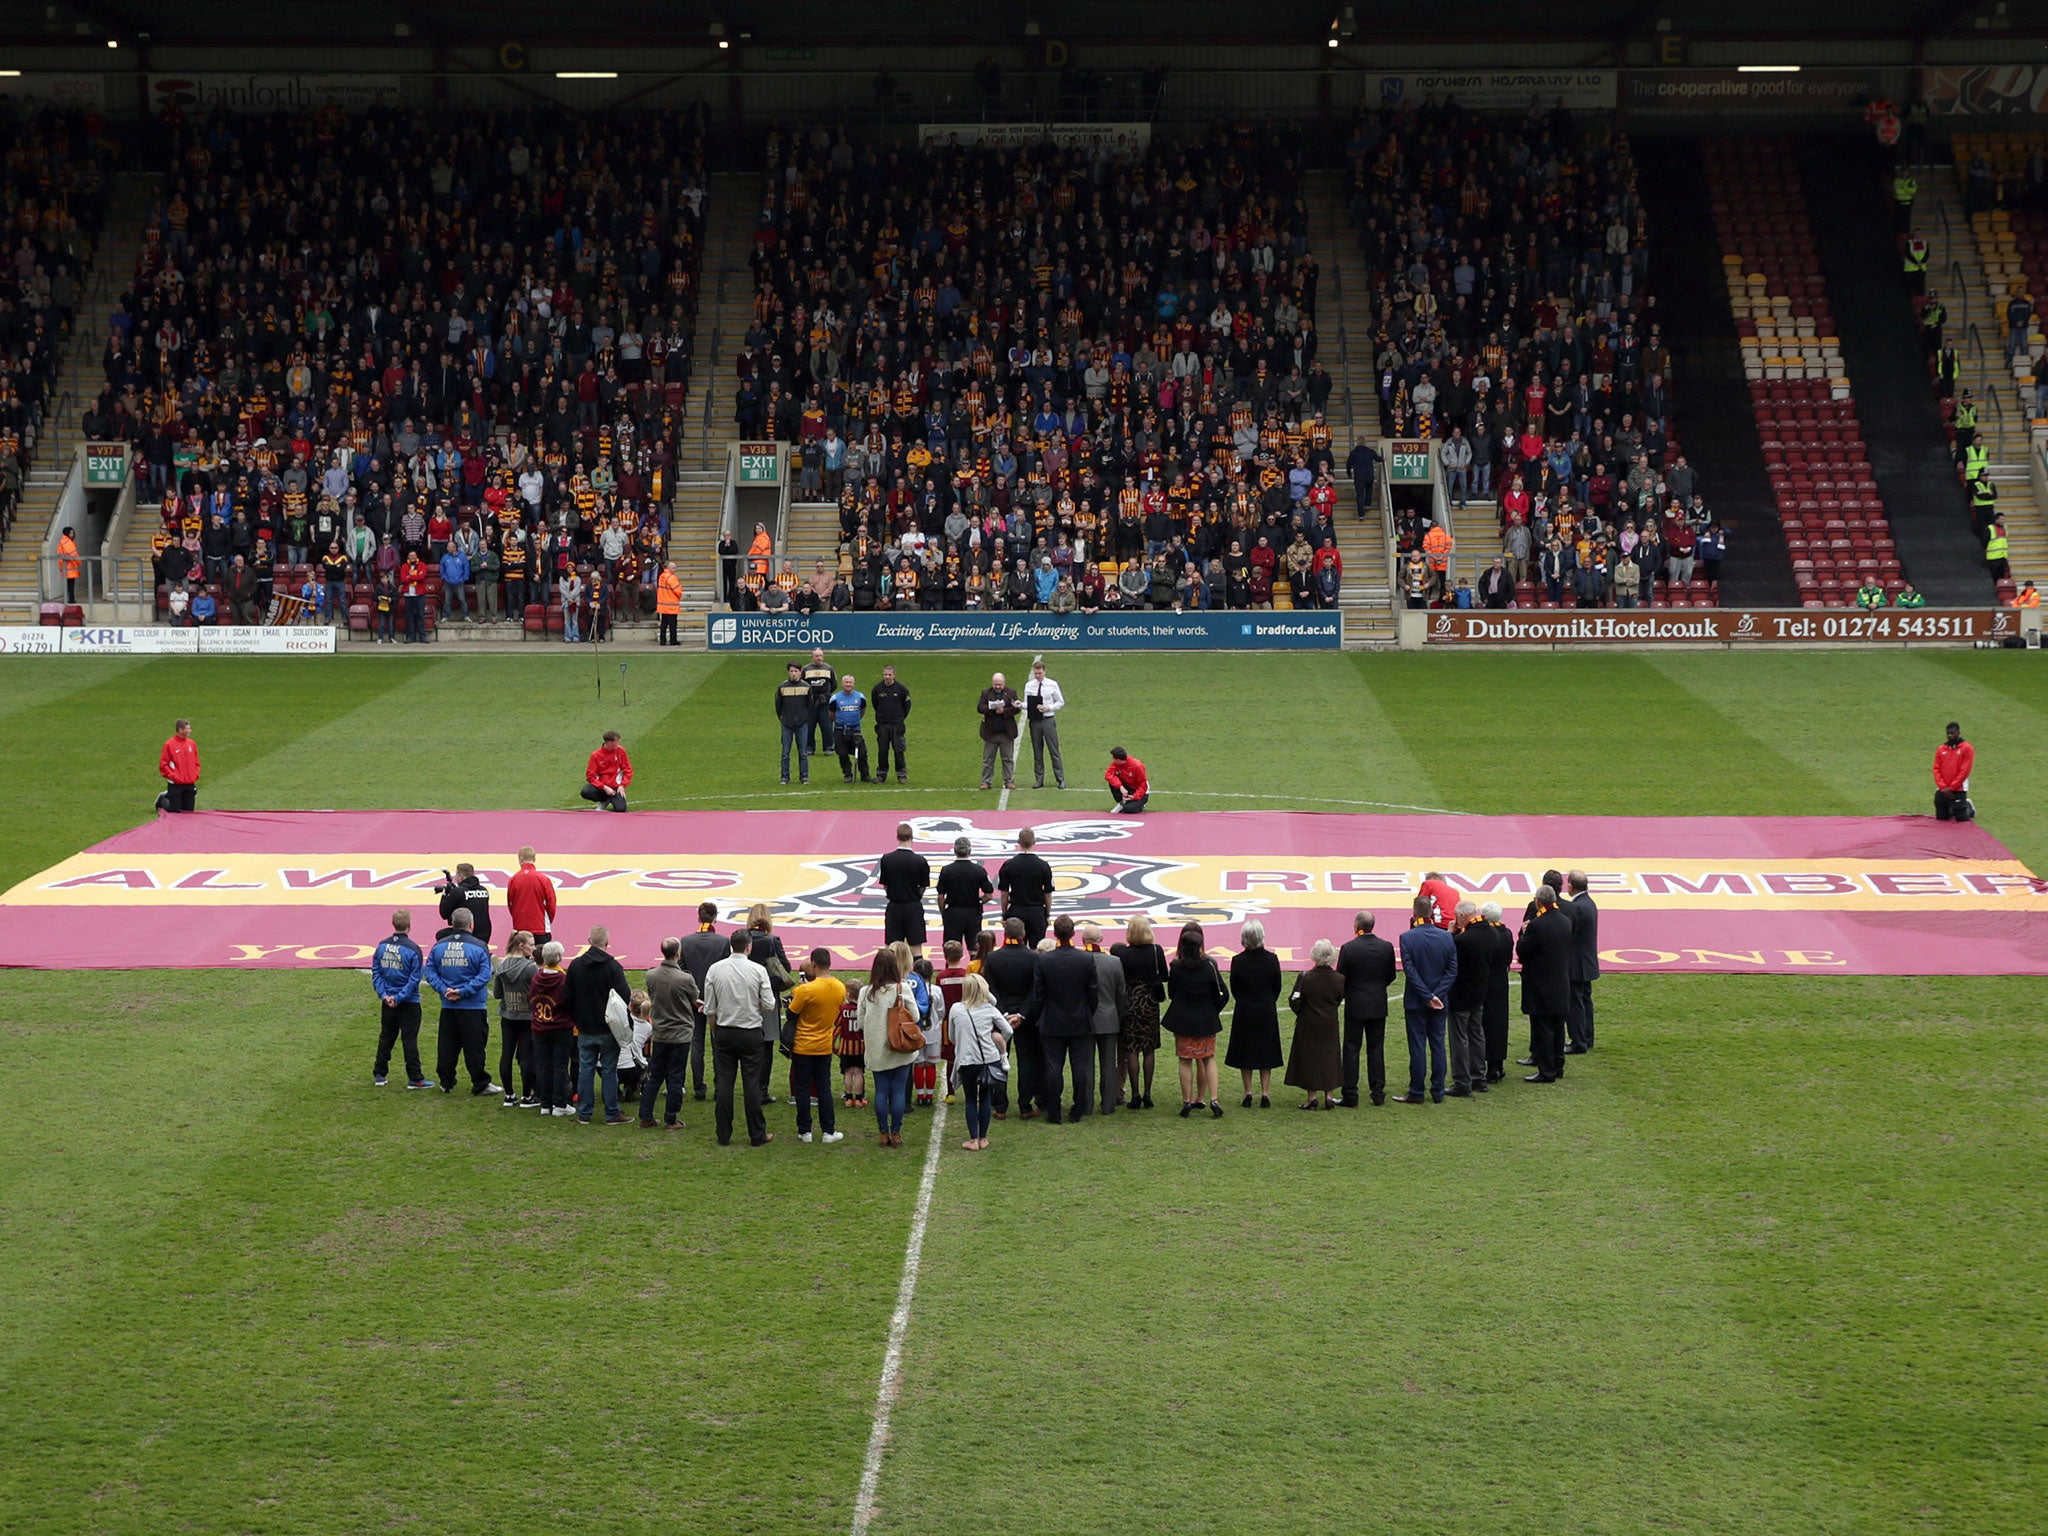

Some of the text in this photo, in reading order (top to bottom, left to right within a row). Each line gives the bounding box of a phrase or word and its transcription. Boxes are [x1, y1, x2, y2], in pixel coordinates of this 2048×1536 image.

[501, 42, 524, 69] C
[1046, 41, 1069, 67] D
[1662, 36, 1683, 63] E
[1632, 81, 1657, 96] The
[1658, 81, 1748, 98] co-operative
[1752, 81, 1785, 98] good
[749, 445, 767, 455] V38
[1401, 443, 1419, 453] V39
[88, 457, 123, 470] EXIT
[741, 456, 776, 469] EXIT
[1393, 454, 1428, 467] EXIT
[741, 619, 810, 628] UNIVERSITY of
[1256, 624, 1337, 635] bradford.ac.uk
[1465, 618, 1719, 639] DubrovnikHotel.co.uk
[1773, 616, 1975, 638] Tel: 01274 543511
[80, 629, 132, 645] KRL
[133, 629, 160, 638] COLOUR
[203, 628, 221, 637] COPY
[233, 628, 251, 637] SCAN
[292, 628, 329, 637] SOLUTIONS
[741, 629, 834, 644] BRADFORD
[876, 623, 1080, 640] Exciting, Exceptional, Life-changing.
[1086, 626, 1209, 637] Our students, their words.
[286, 641, 328, 650] RICOH
[535, 1003, 553, 1020] 30
